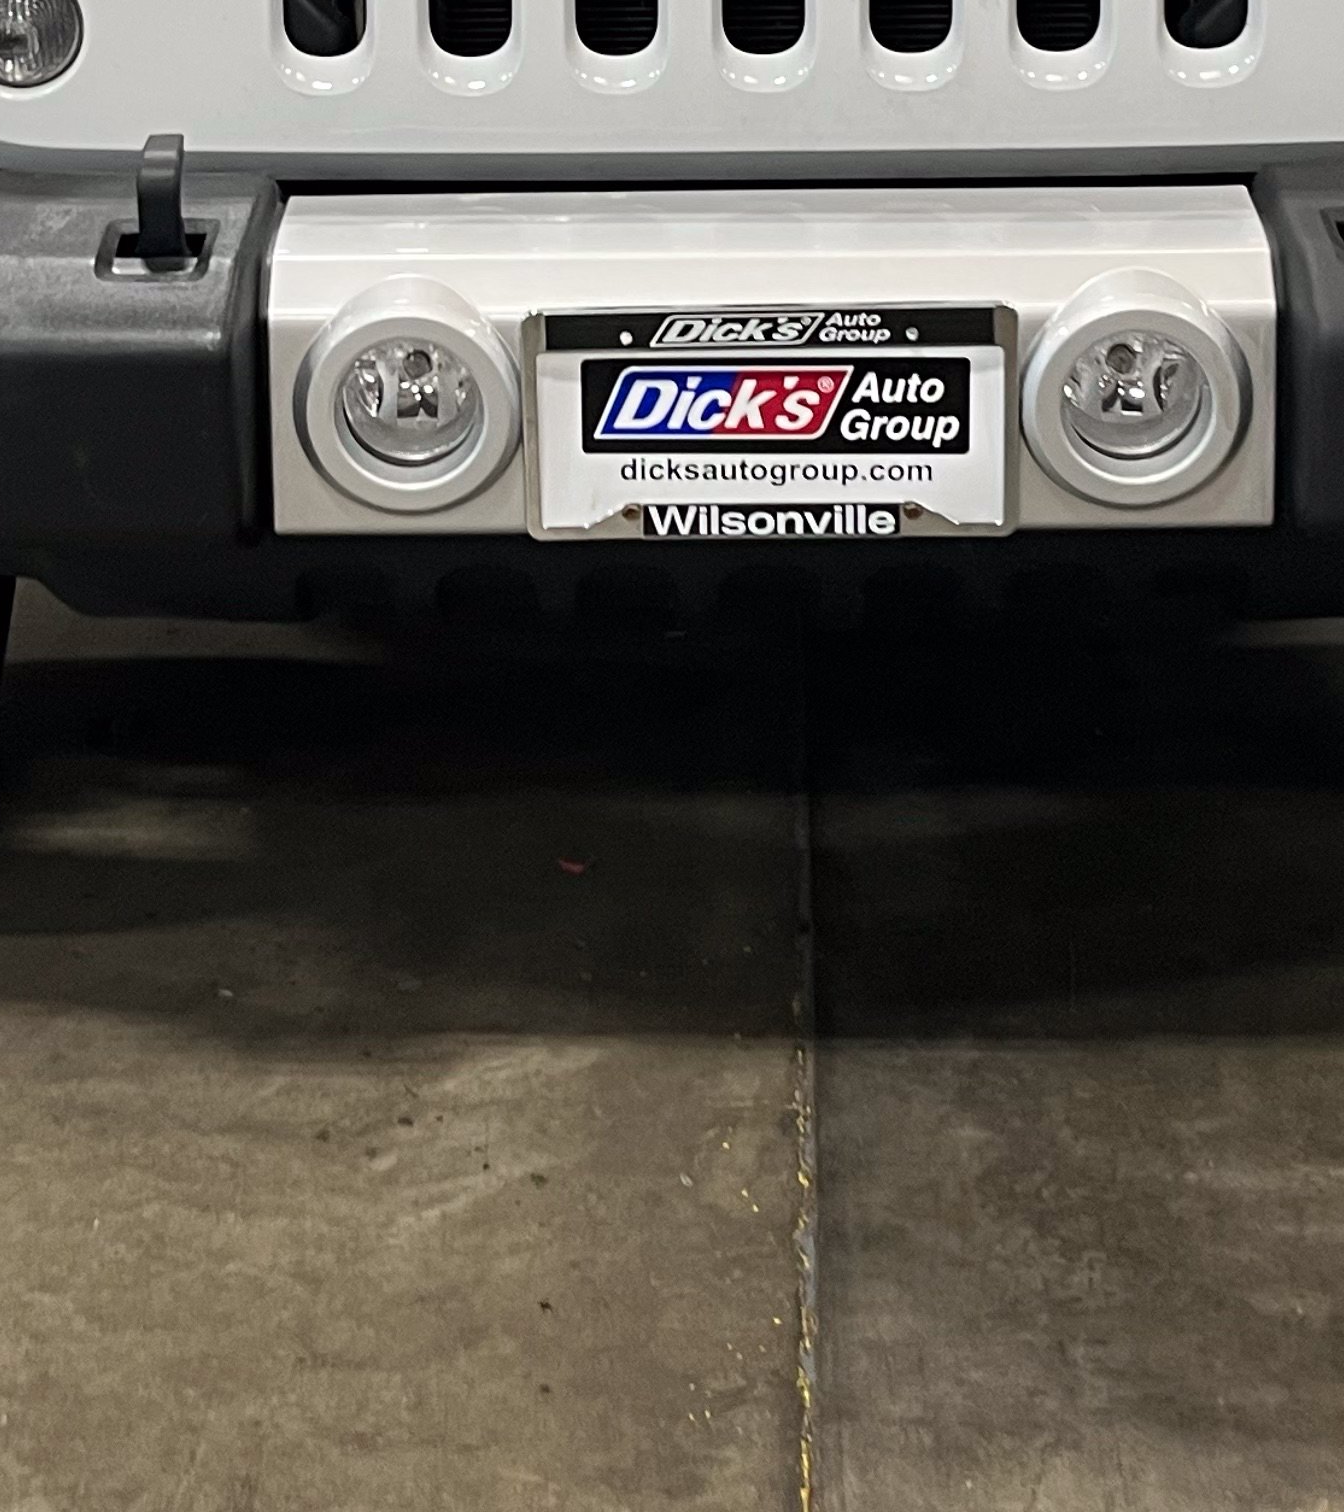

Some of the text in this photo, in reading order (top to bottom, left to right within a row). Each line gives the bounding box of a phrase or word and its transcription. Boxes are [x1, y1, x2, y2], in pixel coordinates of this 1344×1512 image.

[662, 317, 803, 343] Dick's
[825, 312, 881, 327] Auto
[819, 327, 891, 344] Group
[851, 372, 945, 403] Auto
[613, 376, 820, 430] Dick's
[840, 409, 961, 448] Group
[620, 458, 933, 486] dicksautogroup.com
[648, 504, 896, 535] Wilsonville
